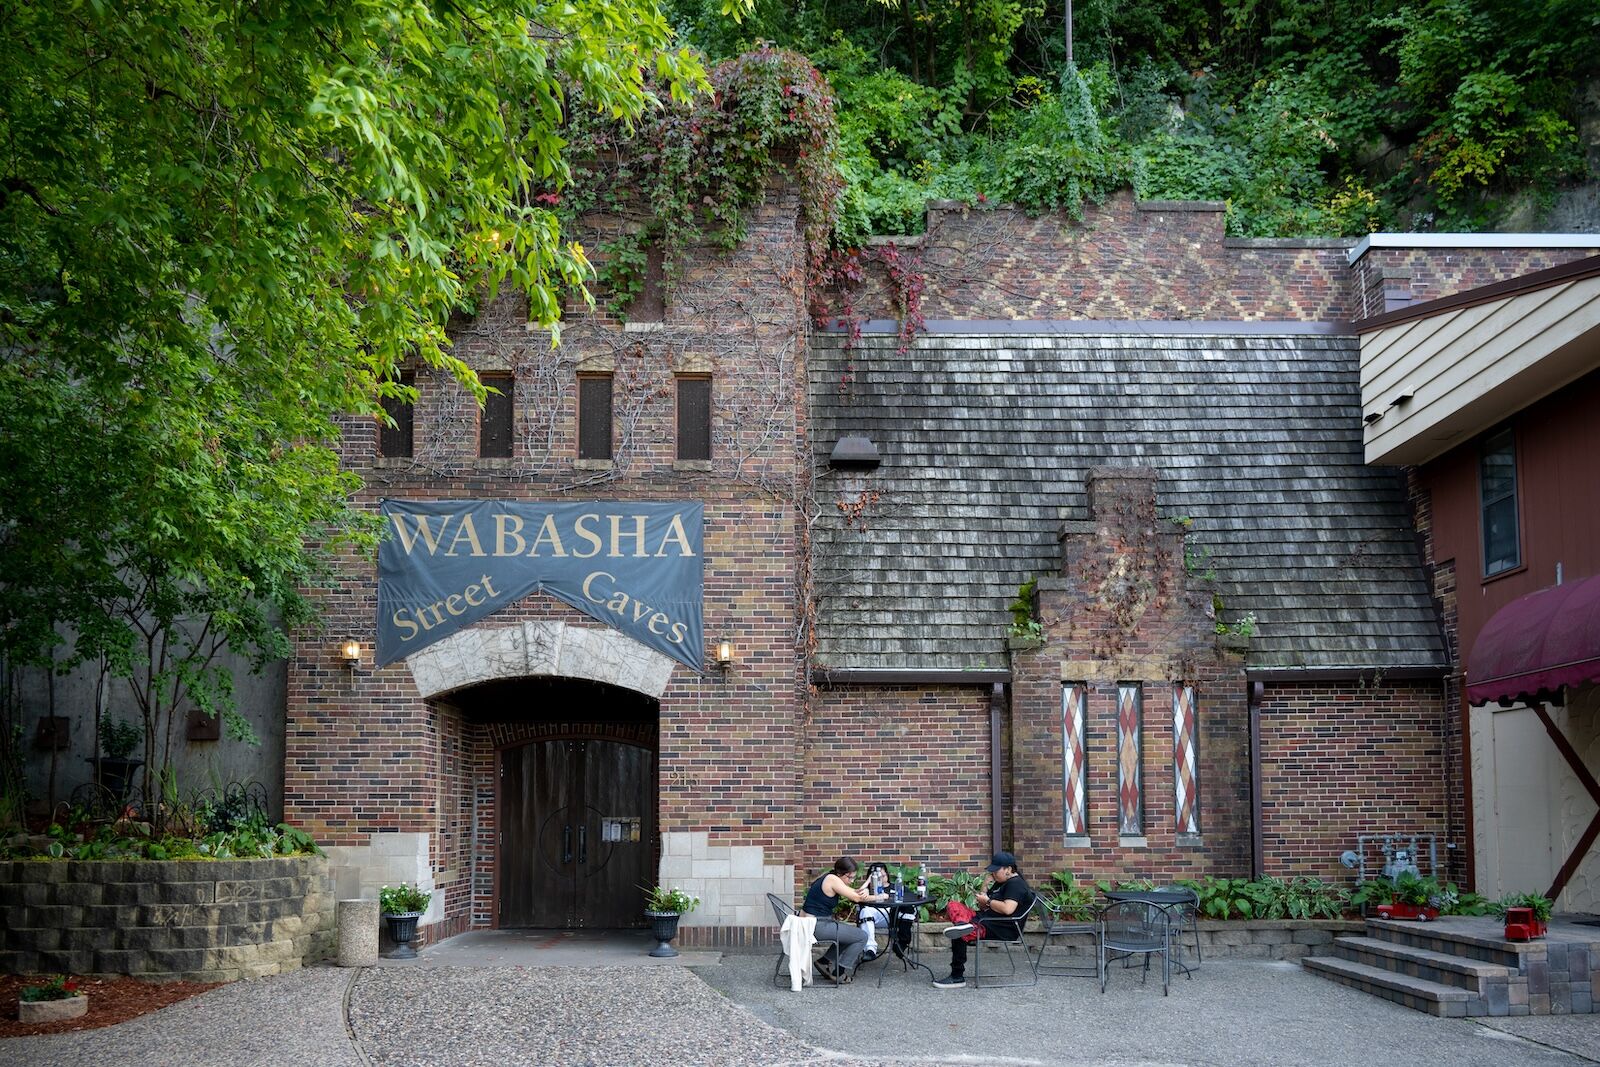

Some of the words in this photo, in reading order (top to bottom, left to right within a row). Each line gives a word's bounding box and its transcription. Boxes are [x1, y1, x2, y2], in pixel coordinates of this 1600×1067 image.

[389, 513, 696, 557] WABASHA
[393, 574, 500, 641] Street
[582, 571, 688, 643] Caves
